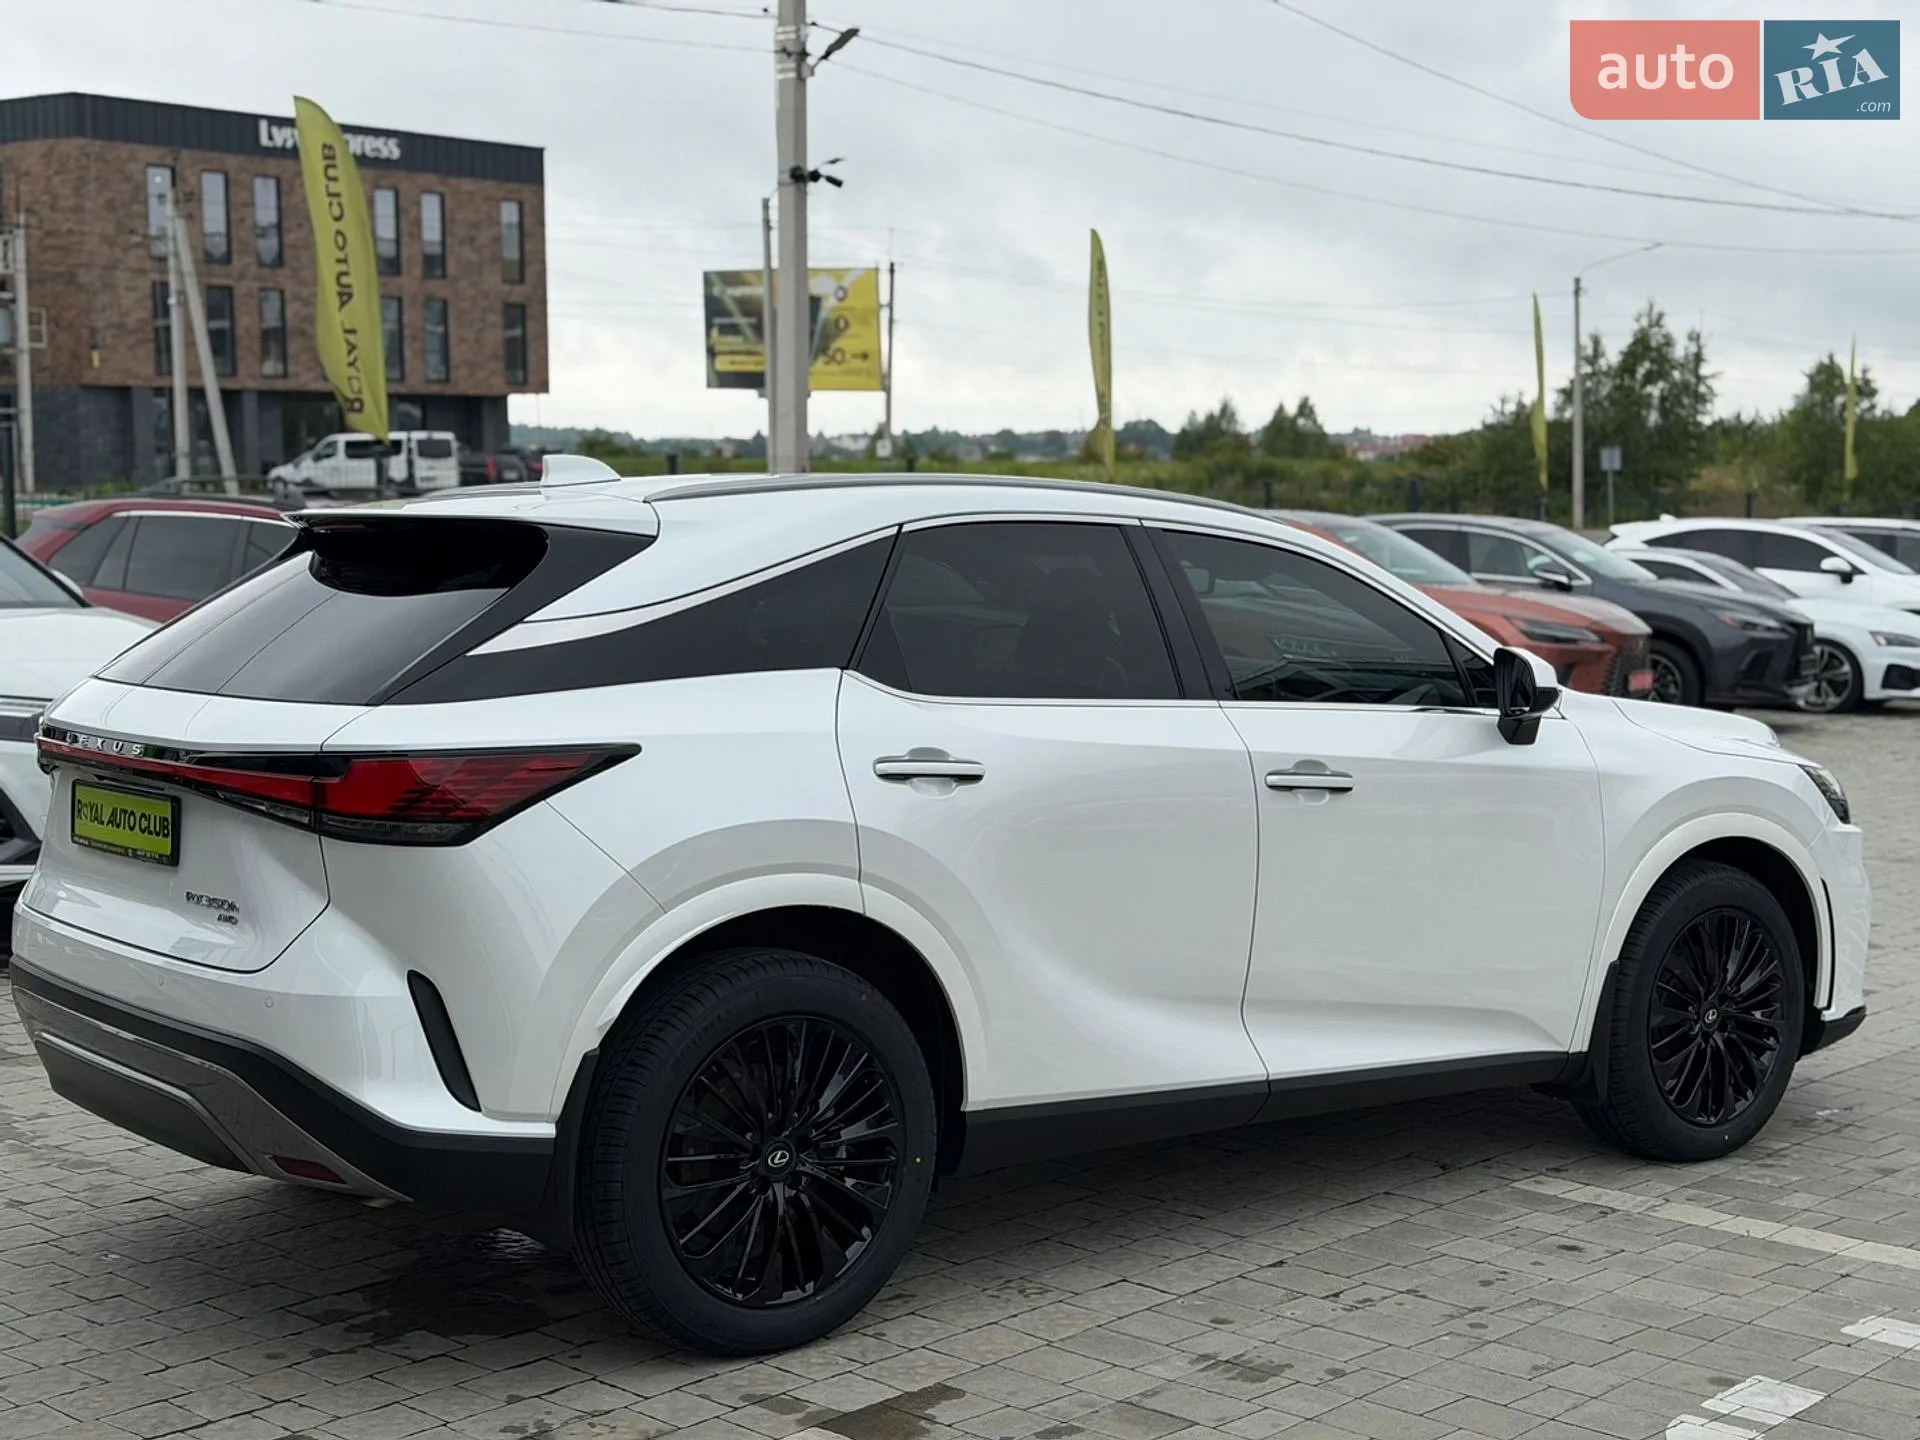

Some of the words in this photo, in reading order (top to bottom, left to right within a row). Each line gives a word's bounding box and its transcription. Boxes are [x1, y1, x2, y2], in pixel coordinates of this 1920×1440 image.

[66, 732, 142, 756] LEXUS
[76, 798, 105, 826] ROYAL
[106, 807, 136, 832] AUTO
[139, 812, 170, 838] CLUB
